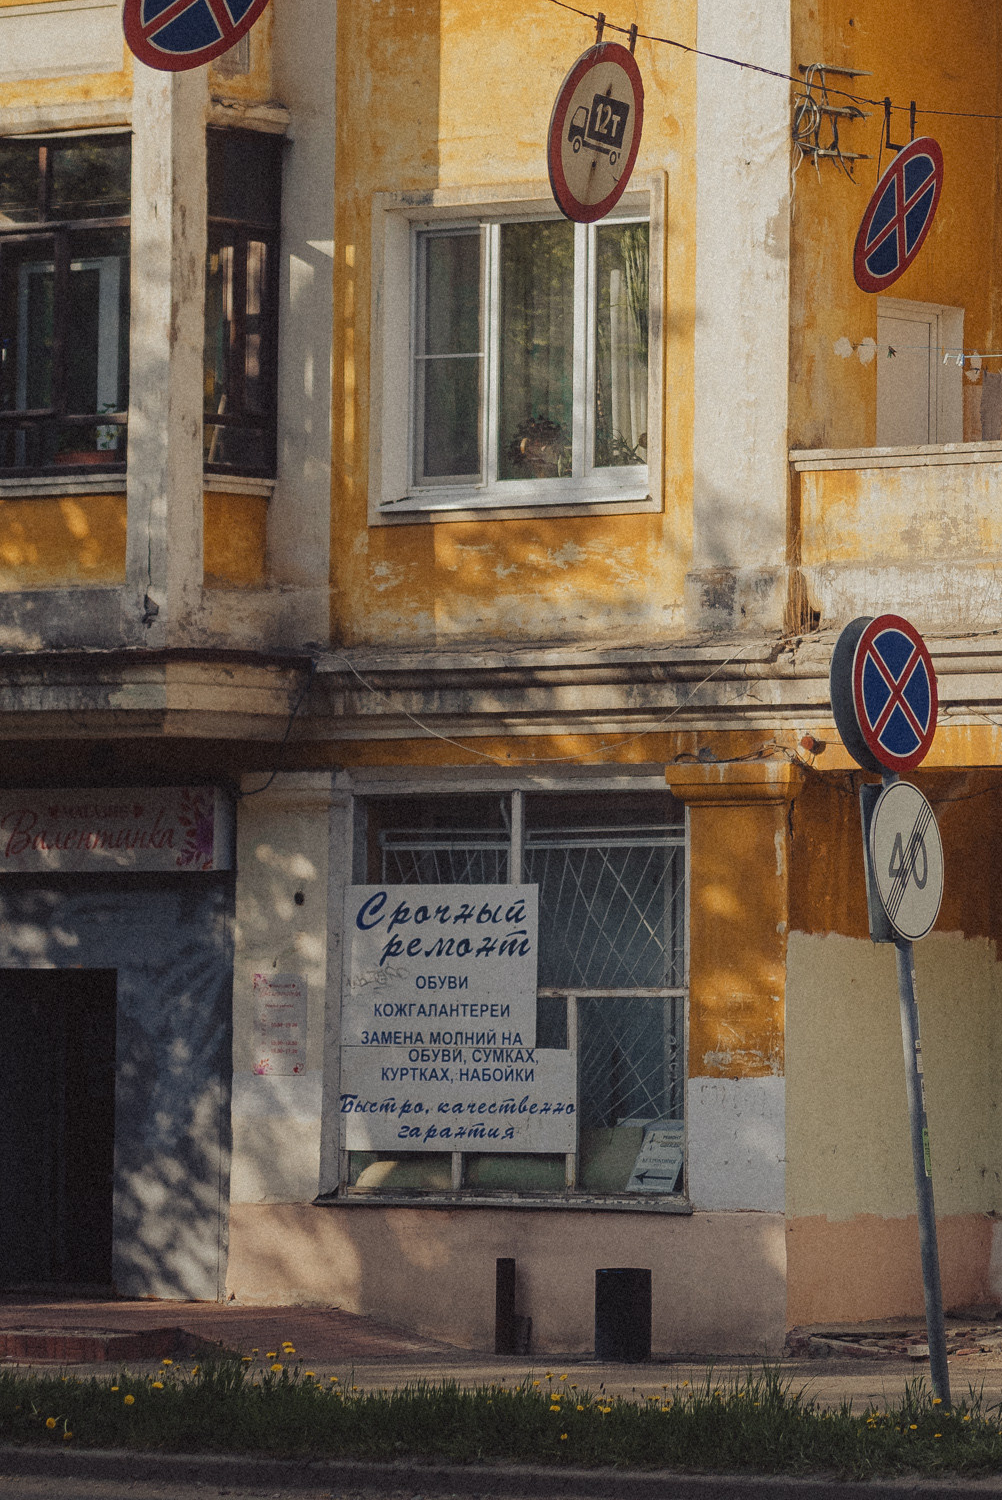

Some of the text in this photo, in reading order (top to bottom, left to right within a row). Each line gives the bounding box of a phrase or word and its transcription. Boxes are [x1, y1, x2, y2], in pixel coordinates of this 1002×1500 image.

[1, 806, 175, 858] Валентинка
[889, 832, 928, 890] 40
[355, 891, 527, 934] Срочный
[379, 929, 531, 967] ремонт
[415, 975, 469, 990] ОБУВИ
[374, 1003, 510, 1018] КОЖГАЛАНТЕРЕИ
[361, 1028, 523, 1046] ЗАМЕНА МОЛНИЙ НА
[408, 1049, 539, 1066] ОБУВИ, СУМКАХ,
[380, 1065, 535, 1084] КУРТКАХ, НАБОЙКИ
[437, 1095, 576, 1115] качественно
[397, 1122, 516, 1143] гарантия
